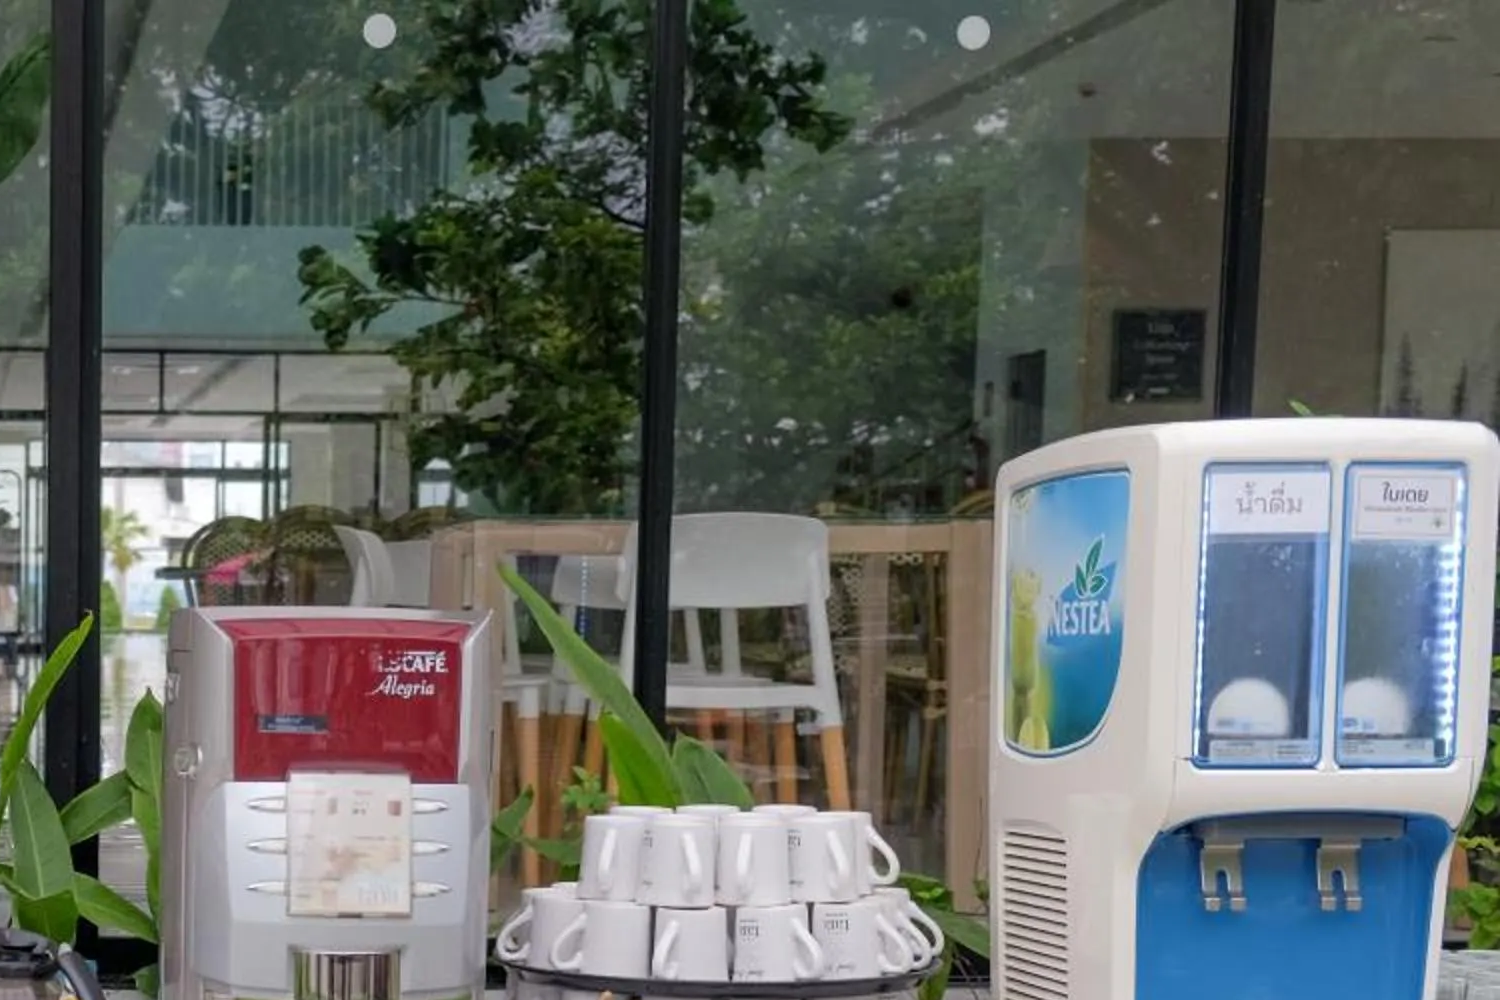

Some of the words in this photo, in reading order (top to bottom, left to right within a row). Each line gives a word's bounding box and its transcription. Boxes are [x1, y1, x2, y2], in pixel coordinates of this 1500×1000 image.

[1235, 480, 1304, 516] น้ำดื่ม
[1048, 598, 1112, 637] NESTEA
[364, 674, 436, 699] Alegria
